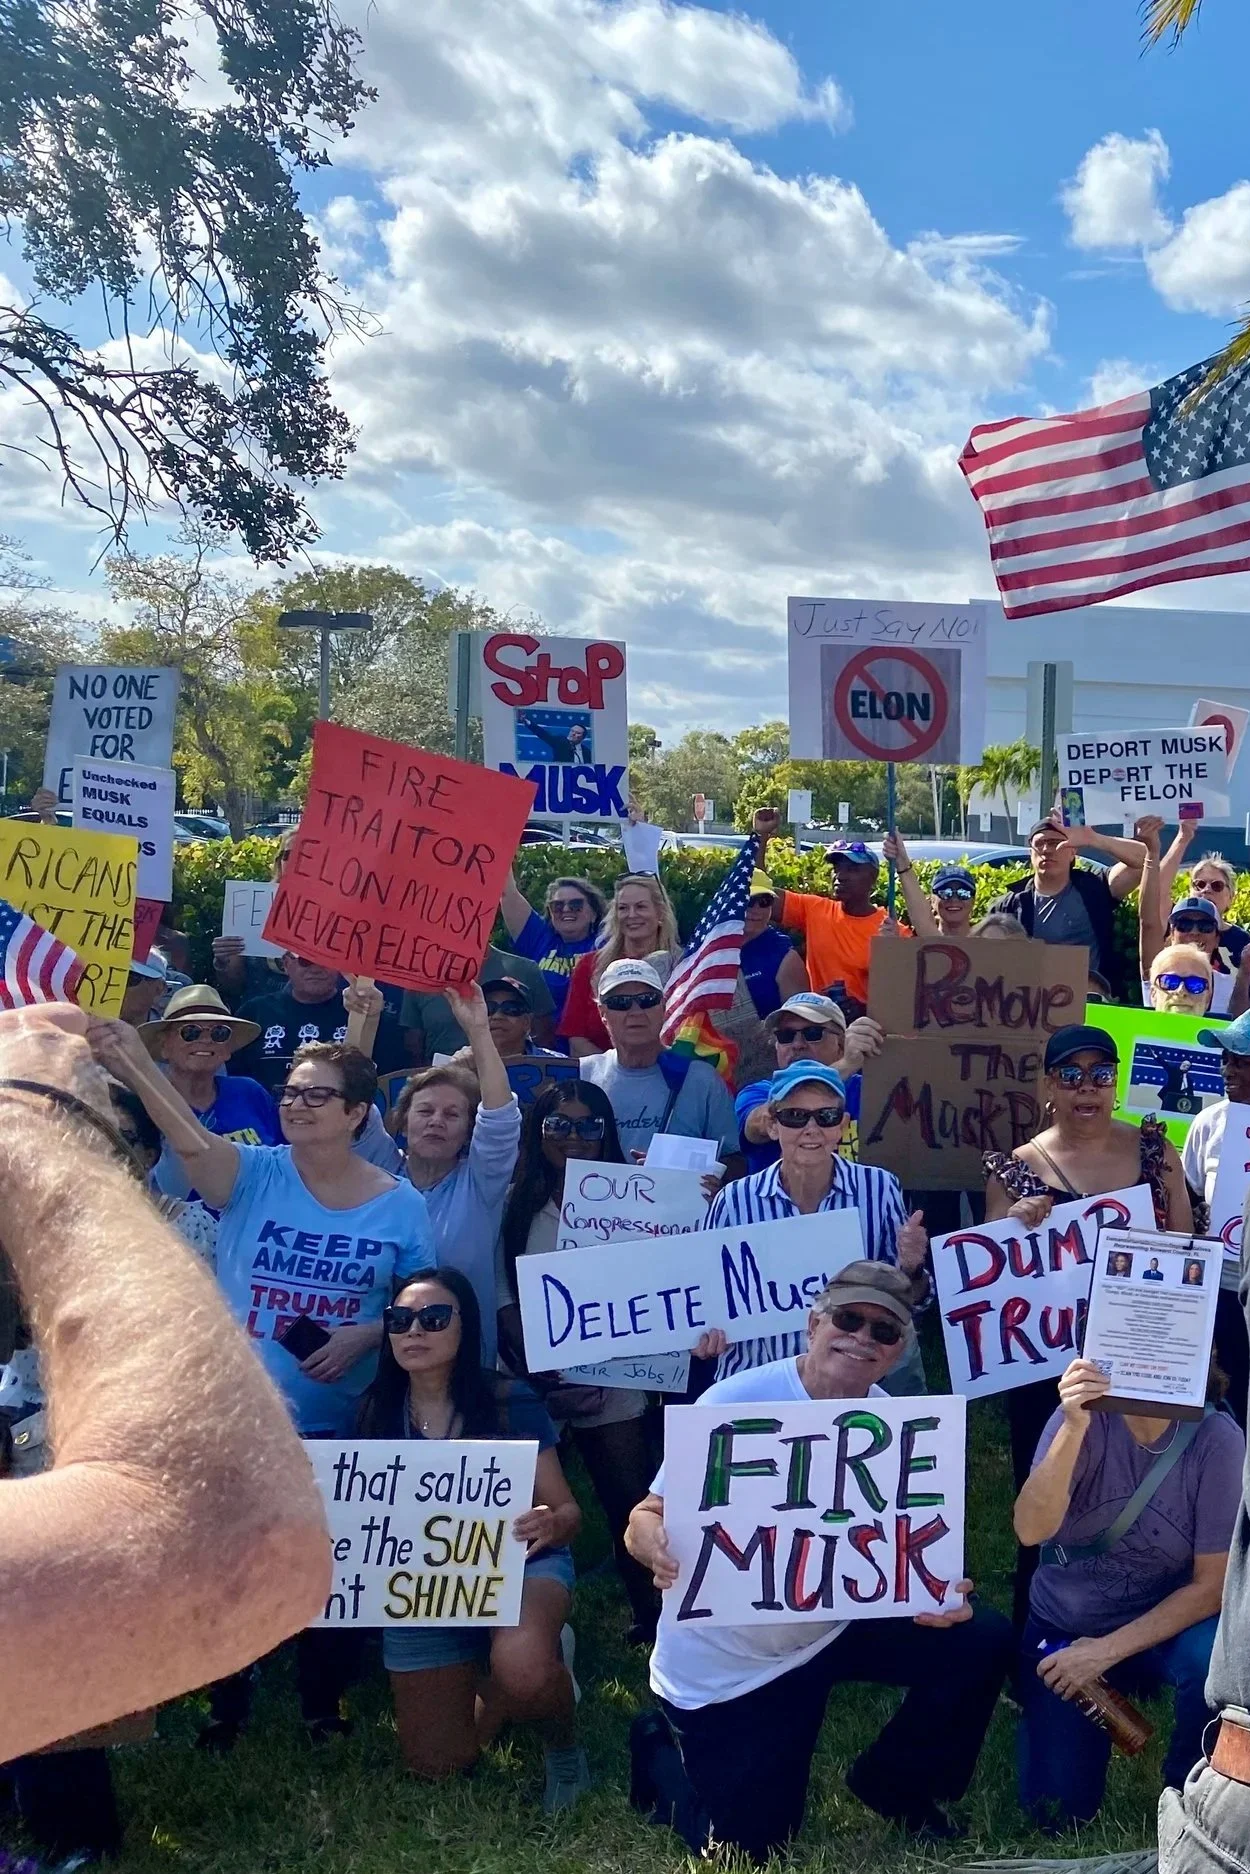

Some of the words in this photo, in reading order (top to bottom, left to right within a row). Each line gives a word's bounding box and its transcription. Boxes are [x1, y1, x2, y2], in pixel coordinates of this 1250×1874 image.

[794, 603, 868, 636] Just
[69, 674, 107, 700] NO
[113, 674, 160, 701] ONE
[851, 690, 930, 721] ELON
[83, 706, 153, 731] VOTED
[90, 733, 136, 762] FOR
[1067, 740, 1151, 760] DEPORT
[1161, 735, 1223, 756] MUSK
[82, 769, 157, 792] Unchecked
[361, 750, 462, 814] FIRE
[499, 763, 629, 818] MUSK
[1165, 762, 1208, 780] THE
[82, 786, 132, 806] MUSK
[1120, 782, 1193, 802] FELON
[82, 807, 149, 829] EQUALS
[316, 789, 495, 885] TRAITOR
[0, 837, 137, 907] RICANS
[294, 839, 394, 906] ELON
[400, 879, 492, 949] MUSK
[79, 909, 133, 950] THE
[272, 891, 371, 964] NEVER
[375, 924, 480, 984] ELECTED
[74, 963, 127, 1007] RE
[579, 1172, 656, 1203] OUR
[257, 1220, 382, 1260] KEEP
[252, 1247, 375, 1288] AMERICA
[250, 1284, 360, 1319] TRUMP
[542, 1274, 706, 1347] DELETE
[246, 1311, 358, 1341] LE
[332, 1451, 406, 1506] that
[414, 1456, 512, 1507] salute
[698, 1410, 945, 1523] FIRE
[361, 1516, 413, 1567] the
[423, 1515, 505, 1568] SUN
[677, 1514, 950, 1621] MUSK
[324, 1574, 365, 1620] n't
[384, 1571, 503, 1619] SHINE
